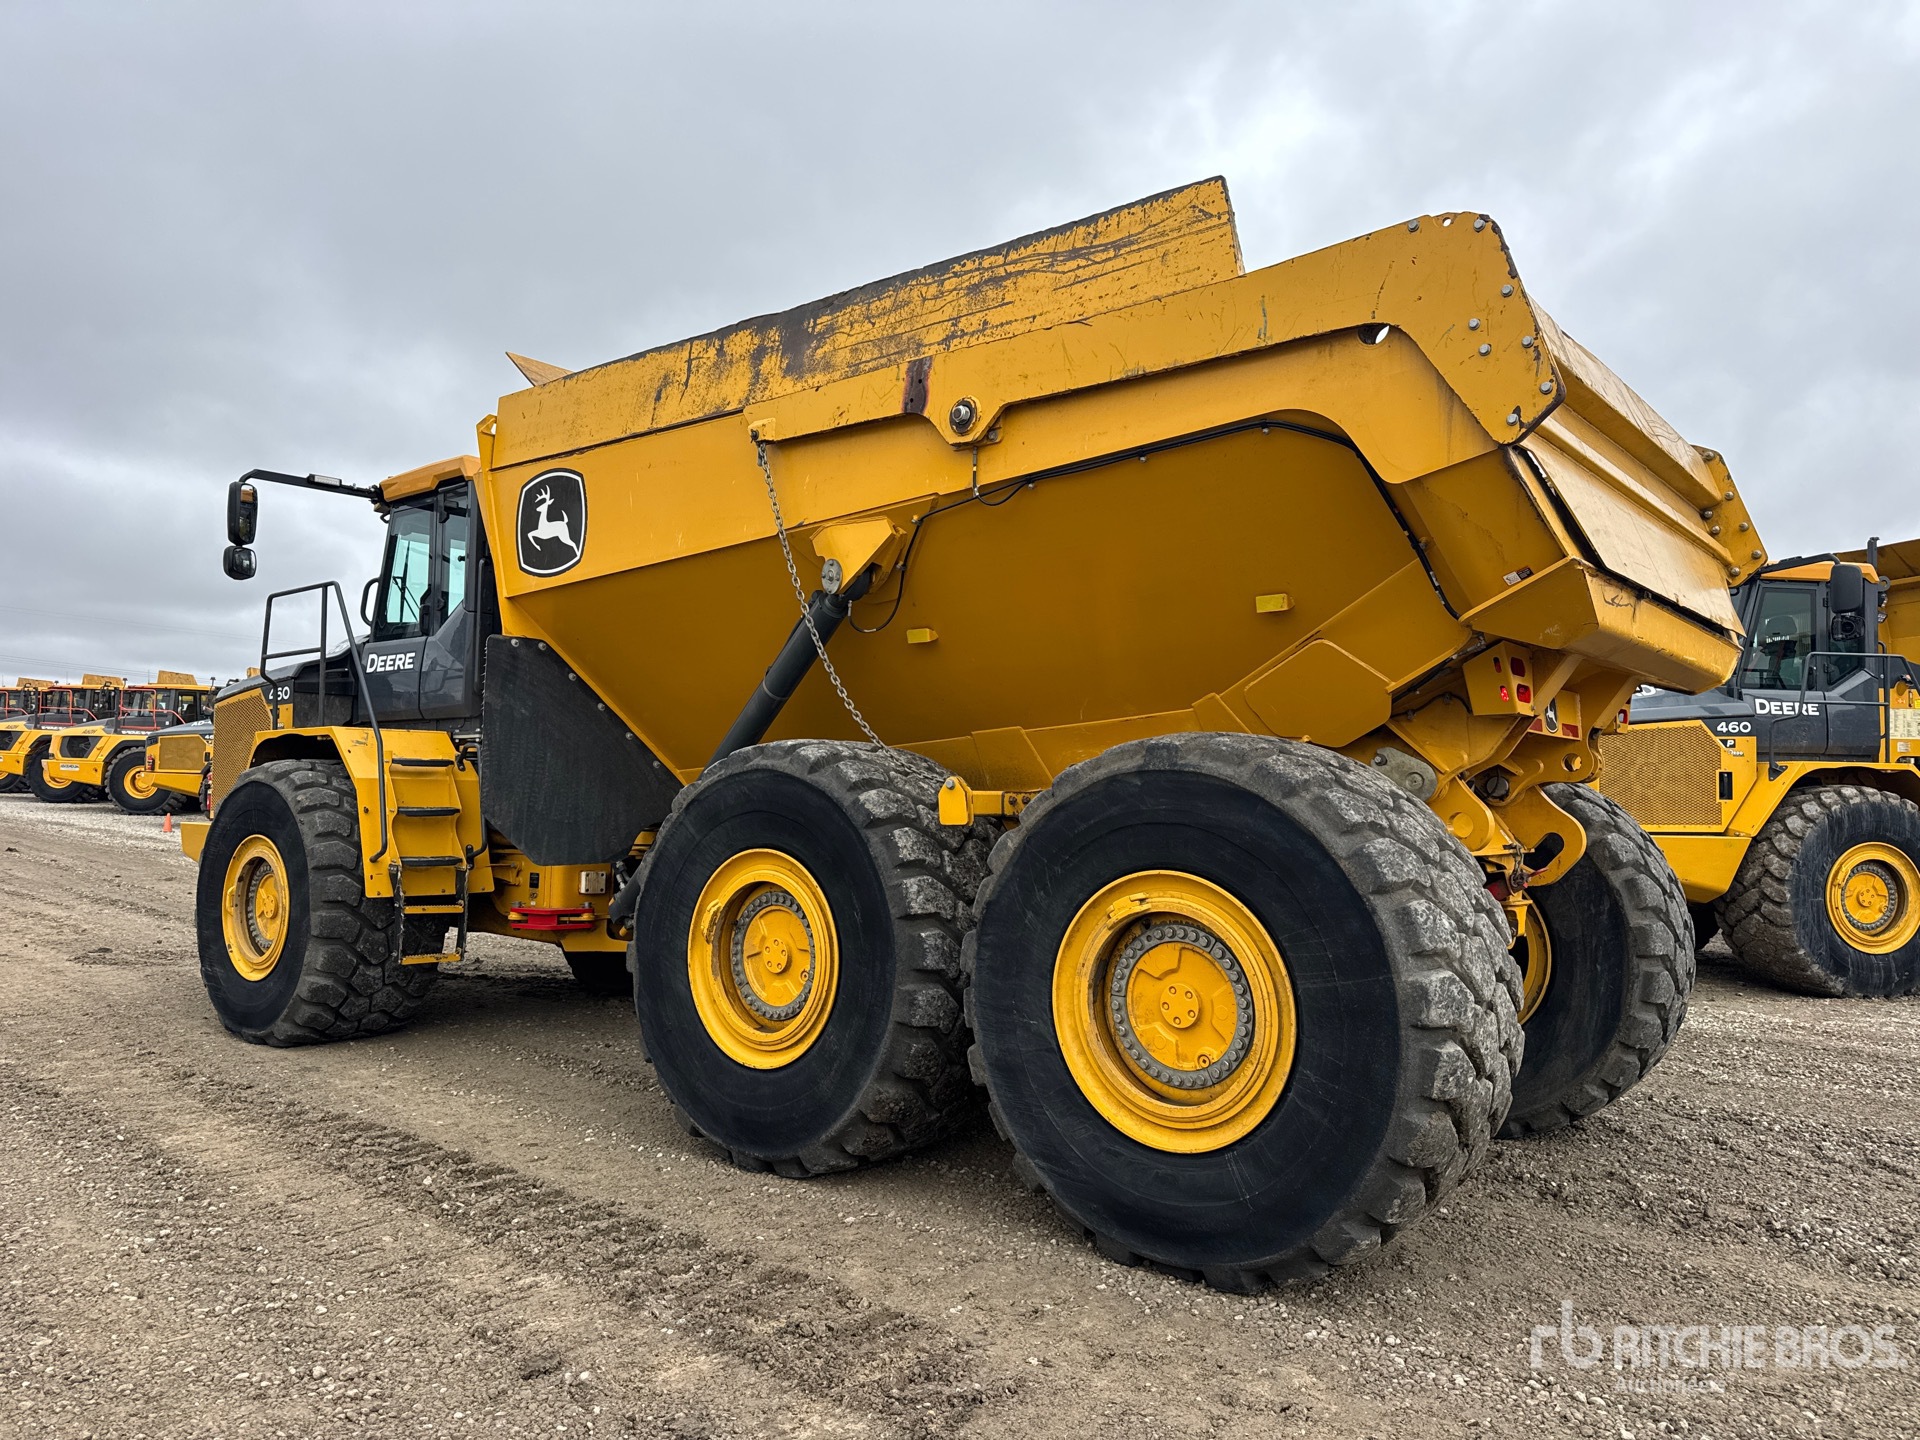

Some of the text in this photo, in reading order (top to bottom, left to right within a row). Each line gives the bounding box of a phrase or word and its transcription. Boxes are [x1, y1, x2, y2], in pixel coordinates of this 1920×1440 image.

[366, 652, 416, 674] DEERE
[1755, 698, 1819, 716] DEERE
[1716, 721, 1751, 733] 460
[1726, 739, 1735, 748] P
